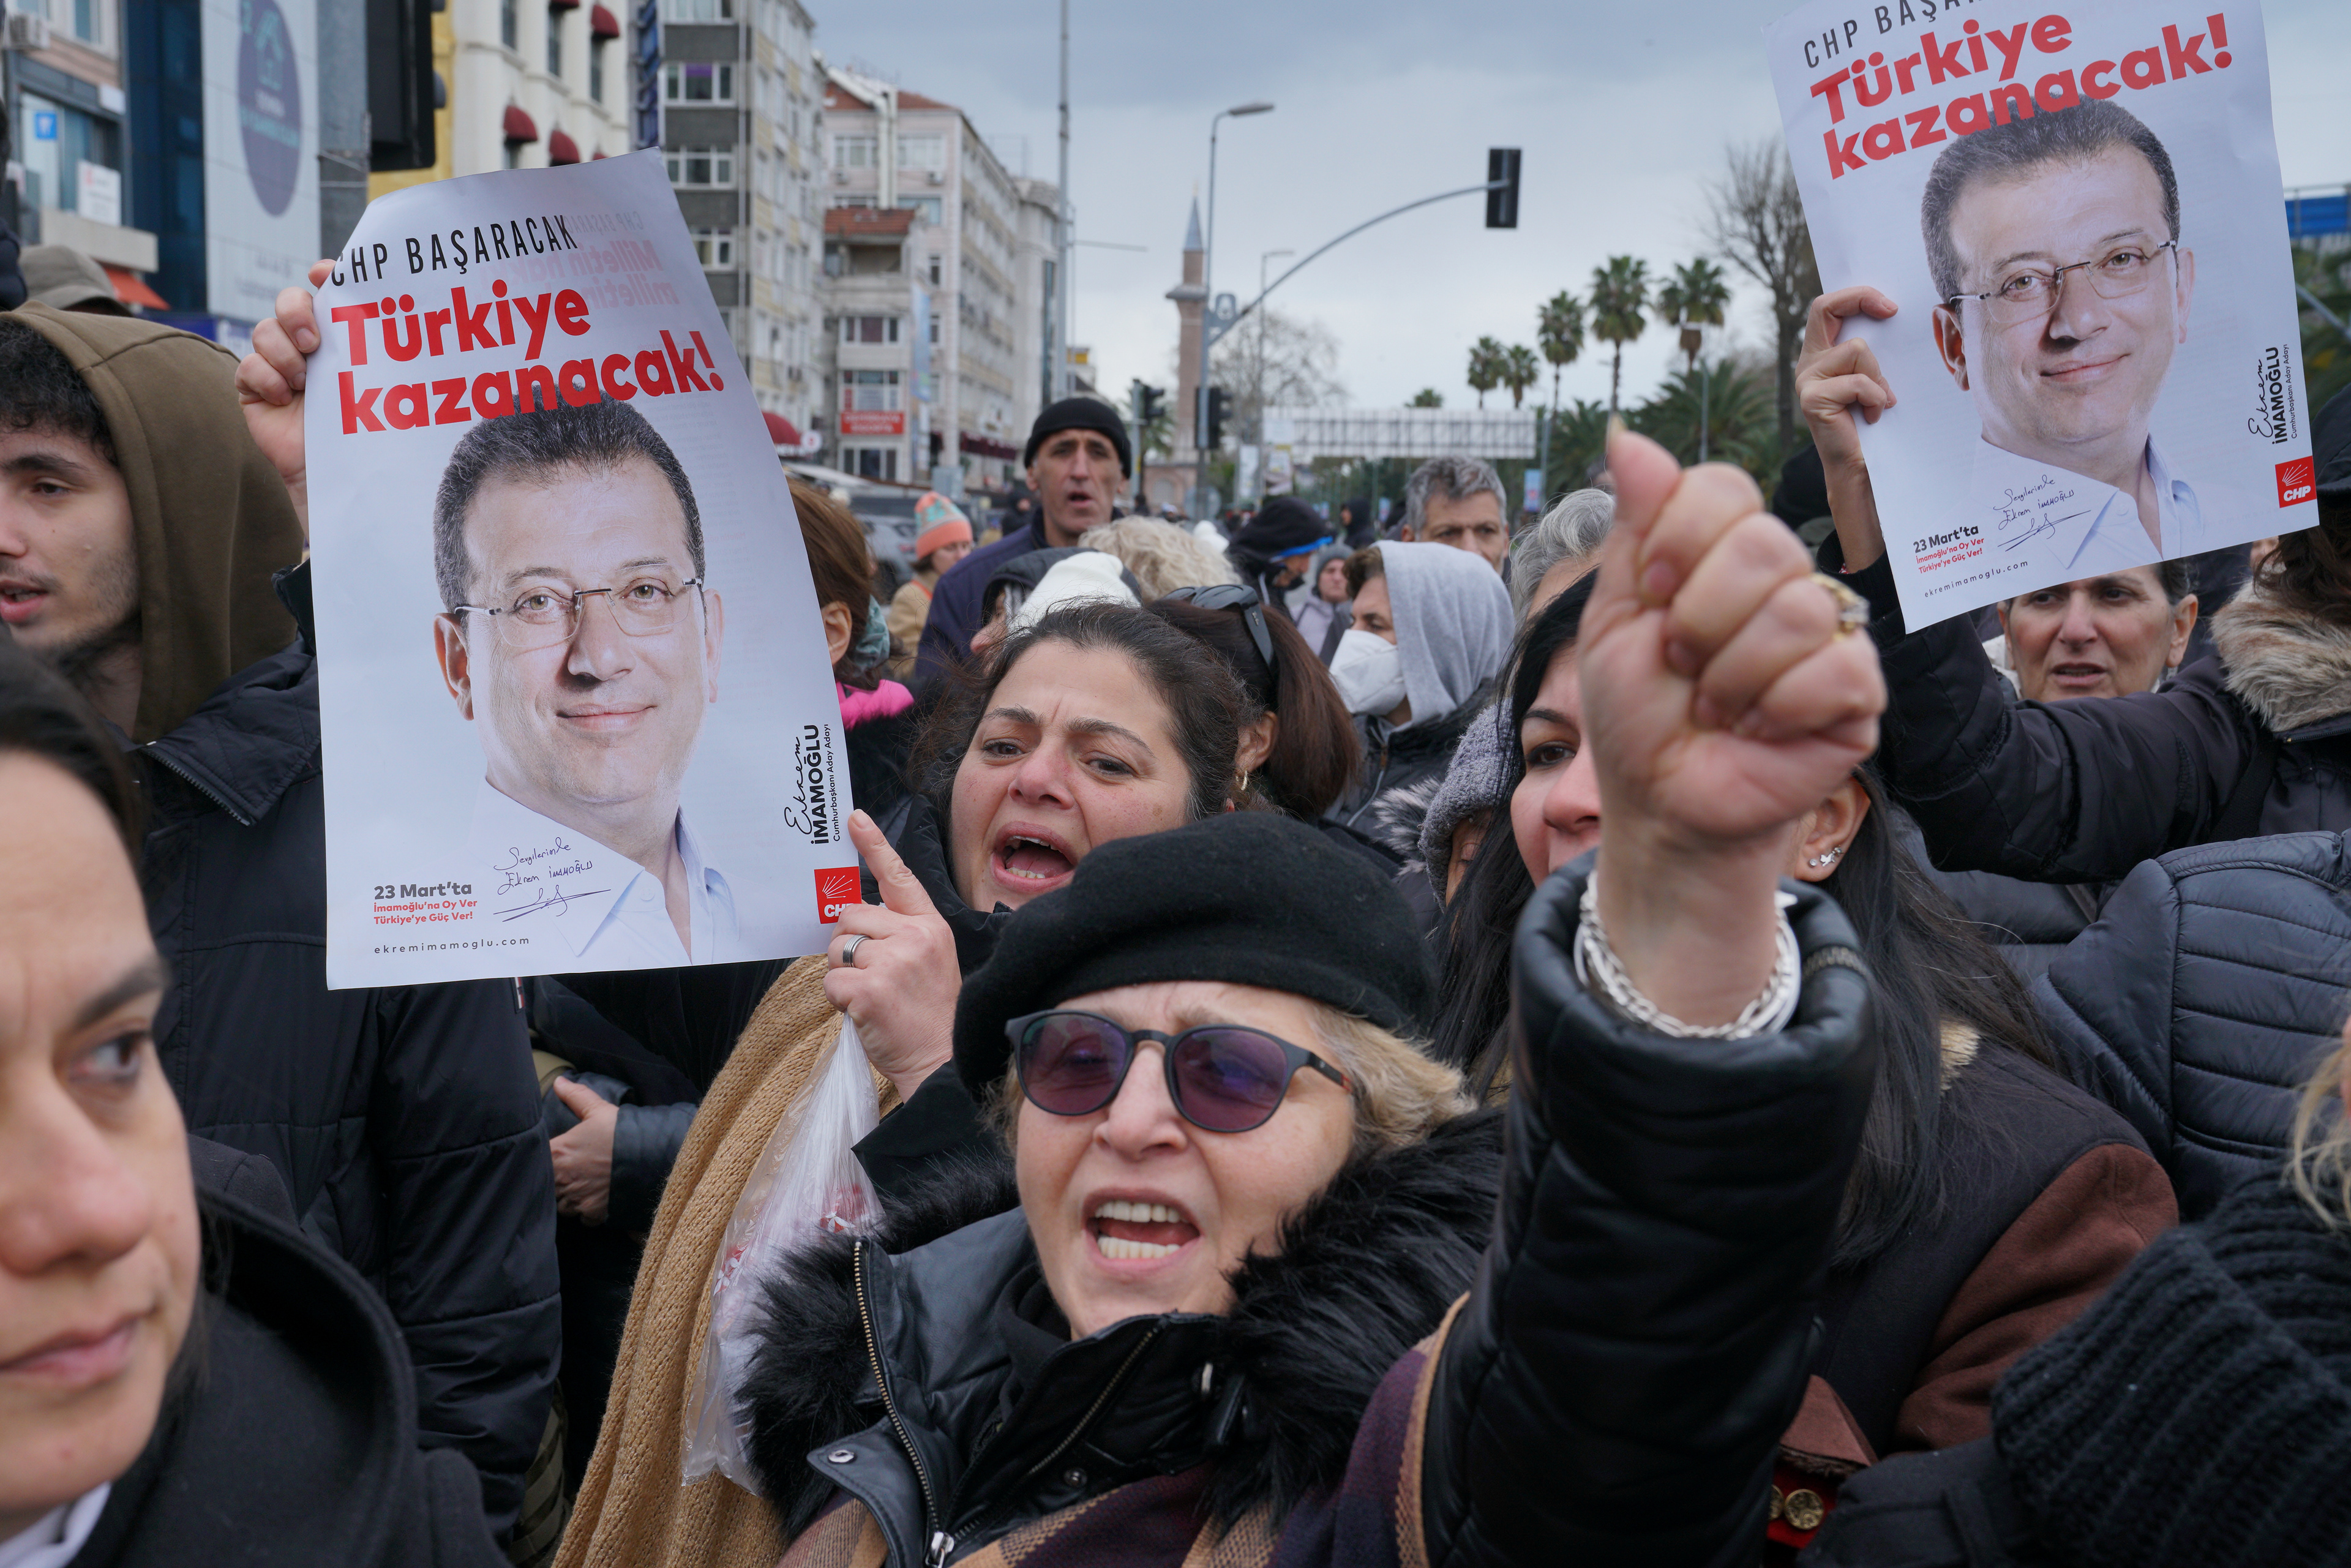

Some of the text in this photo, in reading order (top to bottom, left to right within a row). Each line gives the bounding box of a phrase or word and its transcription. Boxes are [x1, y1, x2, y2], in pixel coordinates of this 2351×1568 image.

[1804, 19, 1858, 69] CHP
[1810, 13, 2073, 125] Türkiye
[1822, 12, 2232, 181] kazanacak!
[405, 214, 579, 275] BAŞARACAK
[331, 279, 591, 366] Türkiye
[338, 329, 725, 435] kazanacak!
[2248, 359, 2273, 438] Ekrem
[2265, 346, 2288, 445] İMAMOĞLU
[2287, 384, 2297, 439] Cumhurbaşkanı
[2284, 485, 2311, 501] CHP
[1913, 539, 1927, 553] 23
[1928, 525, 1979, 549] Mart'ta
[1918, 547, 1983, 574] Türkiye'ye Güç Ver!
[1959, 541, 1969, 550] Oy
[1970, 538, 1985, 546] Ver
[1924, 560, 2028, 598] ekremimamoglu.com
[784, 736, 812, 835] Ekrem
[803, 724, 829, 844] İMAMOĞLU
[823, 724, 841, 842] Cumhurbaşkanı Aday Adayı
[374, 881, 472, 899] 23 Mart'ta
[442, 900, 457, 910] Oy
[823, 903, 854, 917] CH
[373, 911, 473, 925] Türkiye'ye Güç Ver!
[374, 937, 529, 954] ekremimamoglu.com
